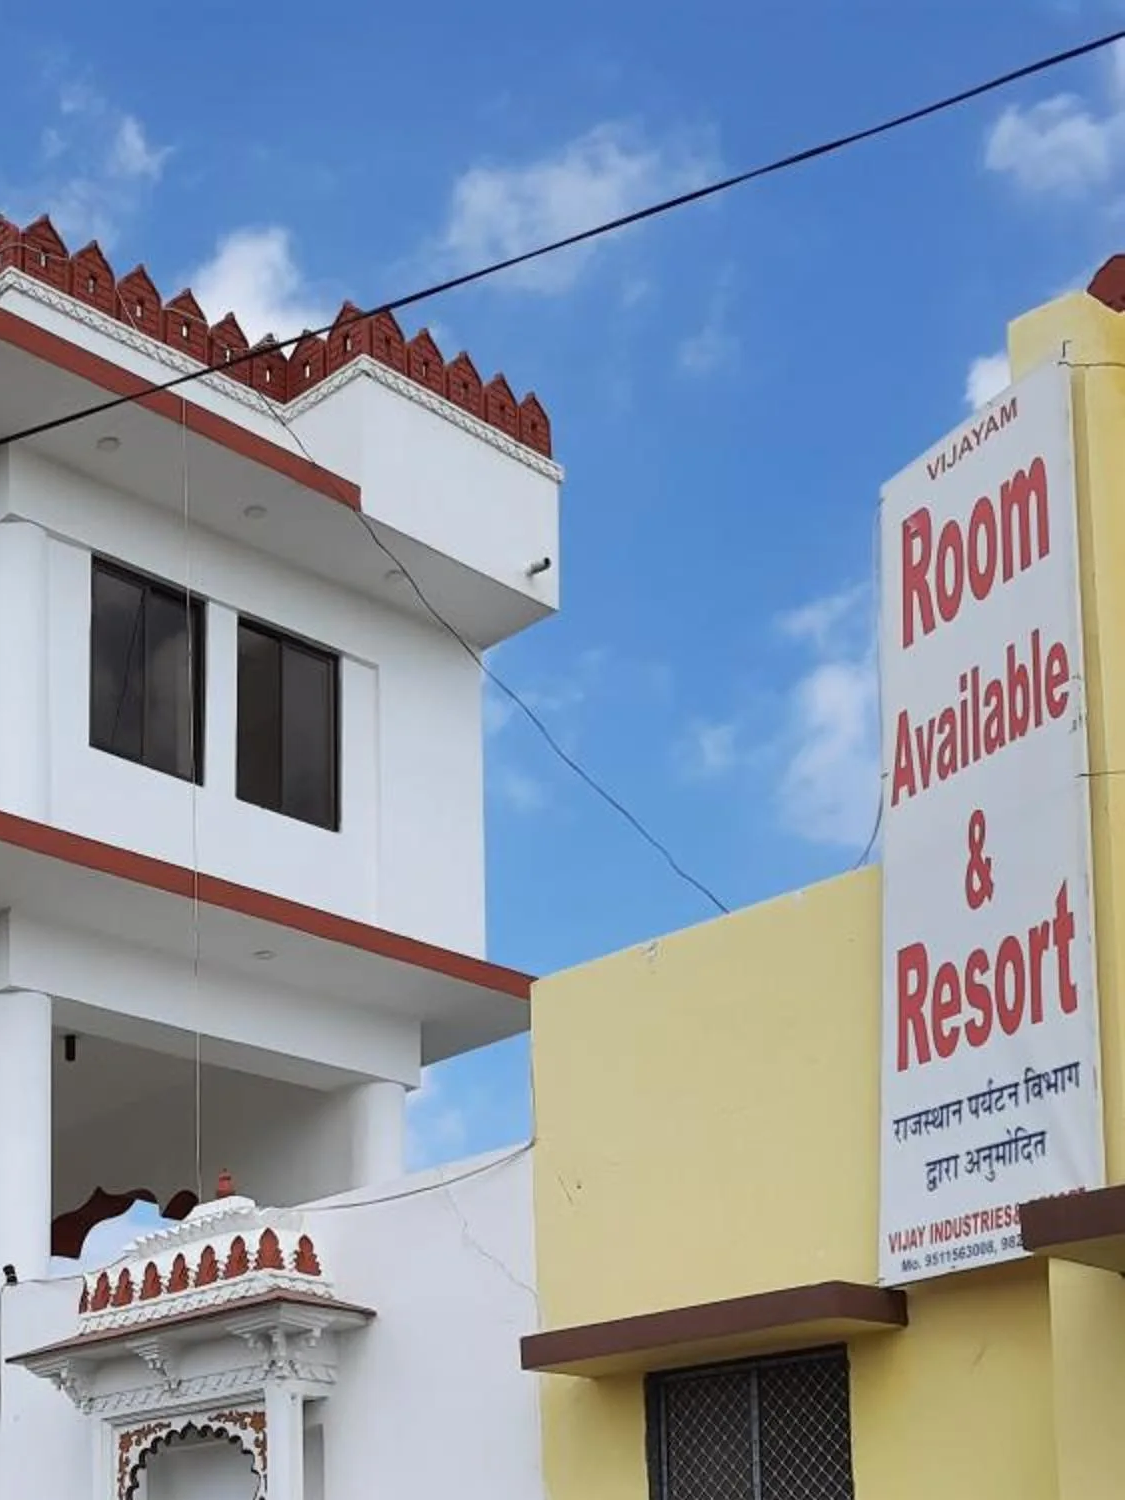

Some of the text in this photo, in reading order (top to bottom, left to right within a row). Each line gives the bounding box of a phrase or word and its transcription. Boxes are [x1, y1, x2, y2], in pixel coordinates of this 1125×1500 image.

[926, 396, 1018, 482] VIJAYAM
[900, 456, 1051, 651] Room
[890, 628, 1070, 808] Available
[965, 809, 993, 910] &
[896, 879, 1079, 1073] Resort
[893, 1061, 1081, 1144] राजस्थान पर्यटन विभाग
[925, 1124, 1048, 1193] द्वारा अनुमोदित
[888, 1225, 926, 1254] VIJAY
[901, 1258, 921, 1273] Mo.
[1001, 1233, 1024, 1251] 982
